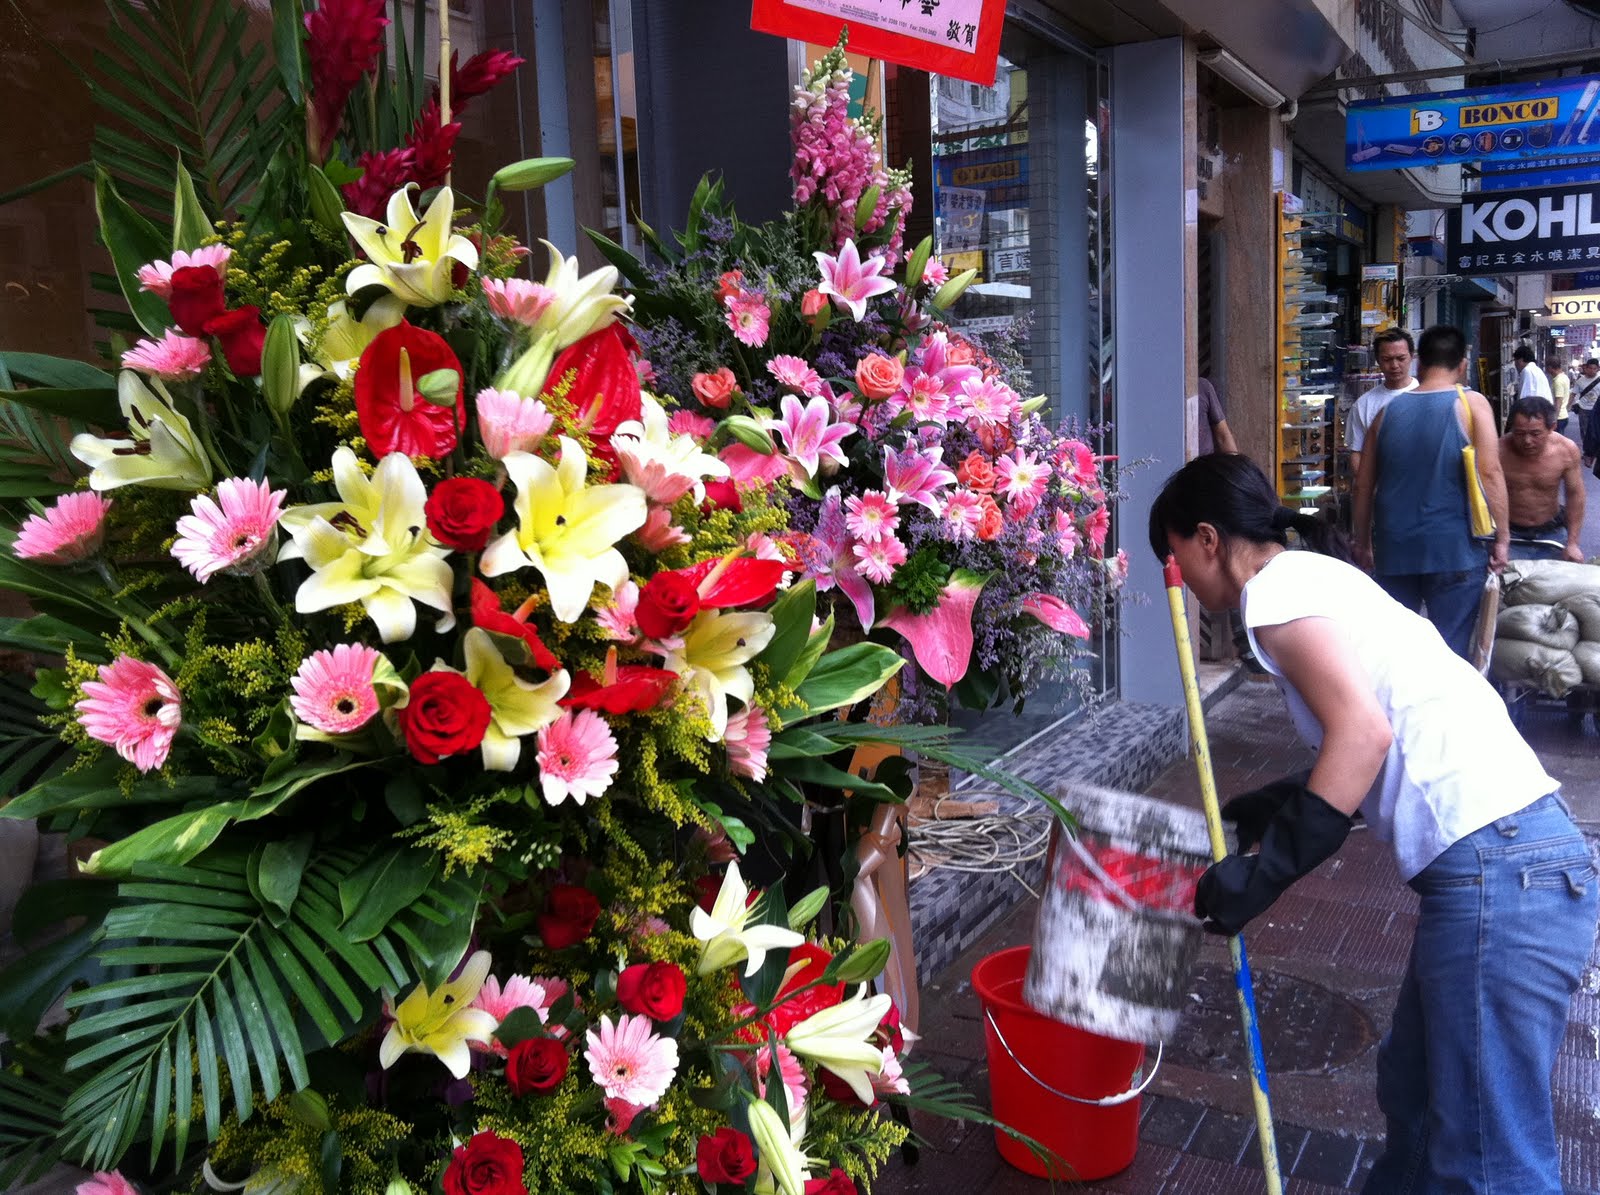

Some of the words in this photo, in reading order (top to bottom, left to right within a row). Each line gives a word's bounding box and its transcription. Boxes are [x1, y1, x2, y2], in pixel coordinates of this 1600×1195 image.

[946, 19, 976, 47] 敬賀
[1463, 101, 1549, 125] BONCO
[1460, 193, 1600, 244] KOHL
[1552, 300, 1600, 315] TOT
